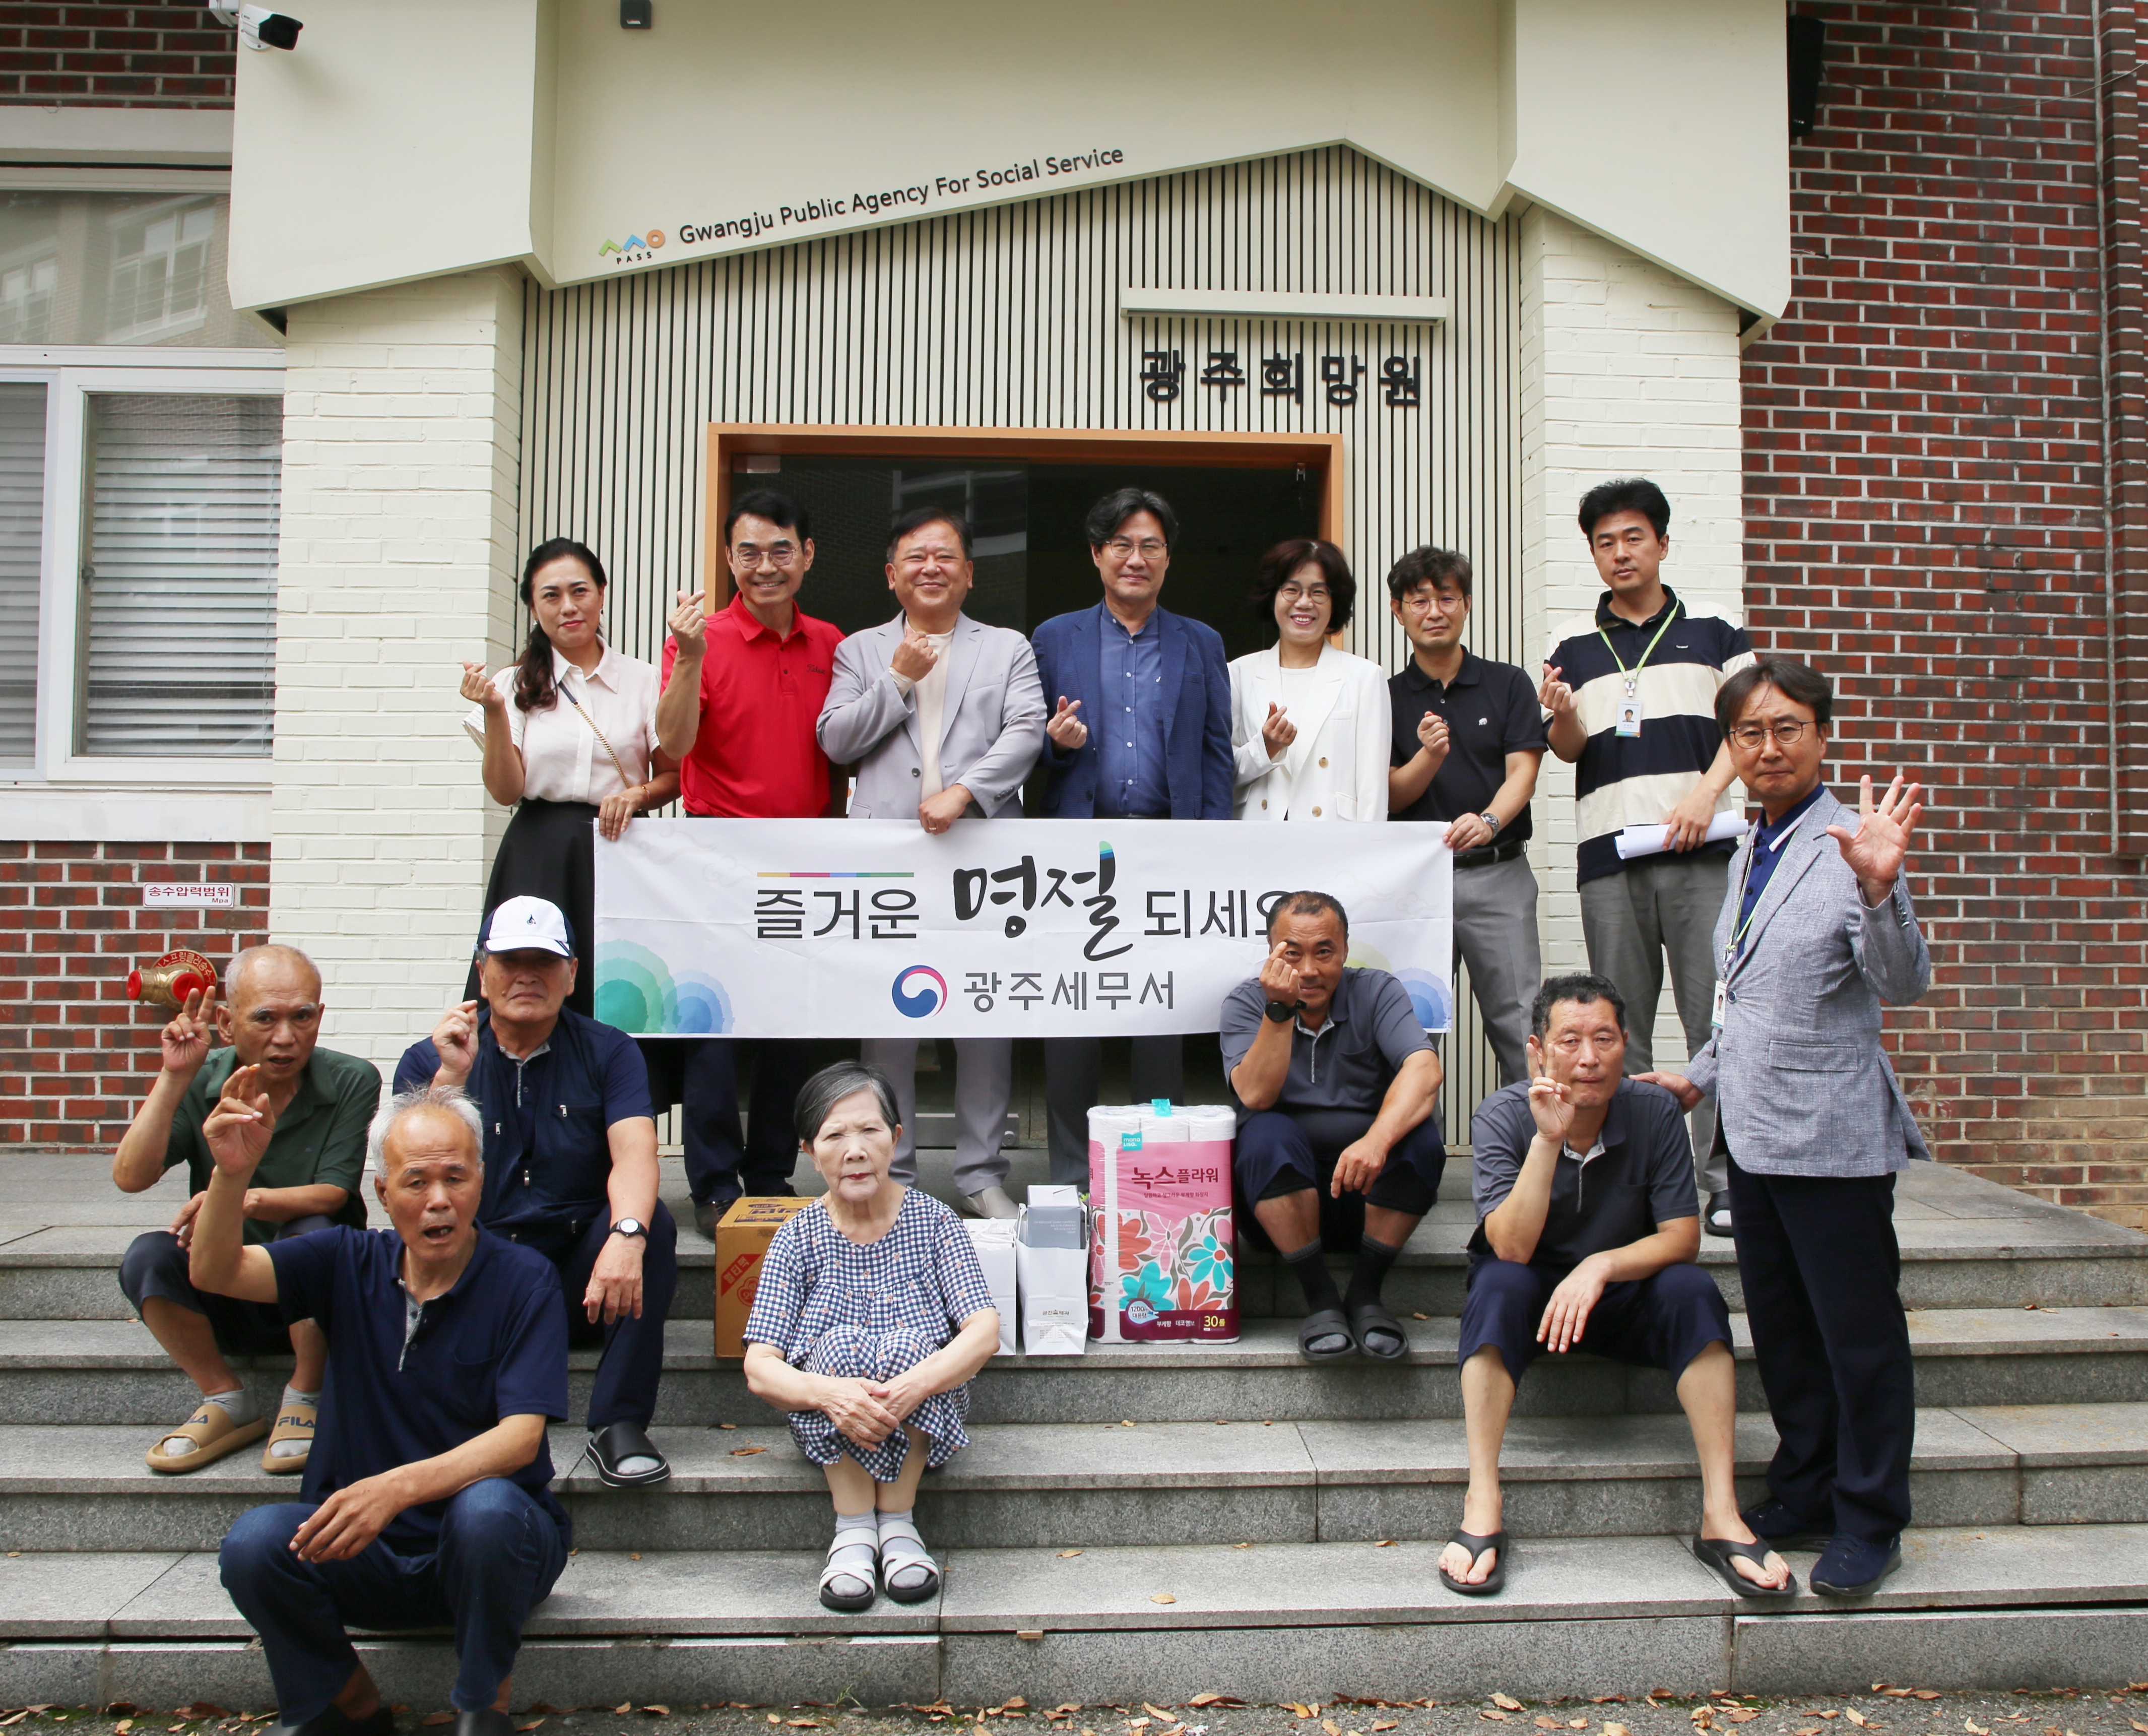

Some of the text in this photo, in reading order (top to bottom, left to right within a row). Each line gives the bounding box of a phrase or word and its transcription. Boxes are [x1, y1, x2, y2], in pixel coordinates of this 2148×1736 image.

[679, 148, 1124, 244] Gwangju Public Agency For Social Service
[616, 251, 653, 265] PASS
[1139, 349, 1421, 407] 광주희망원
[148, 886, 229, 897] 송수압력범위
[753, 889, 919, 939] 즐거운
[952, 840, 1134, 962] 명절
[963, 970, 1174, 1013] 광주세무서
[1131, 1167, 1218, 1190] 녹스플라워
[278, 1416, 315, 1428] FILA
